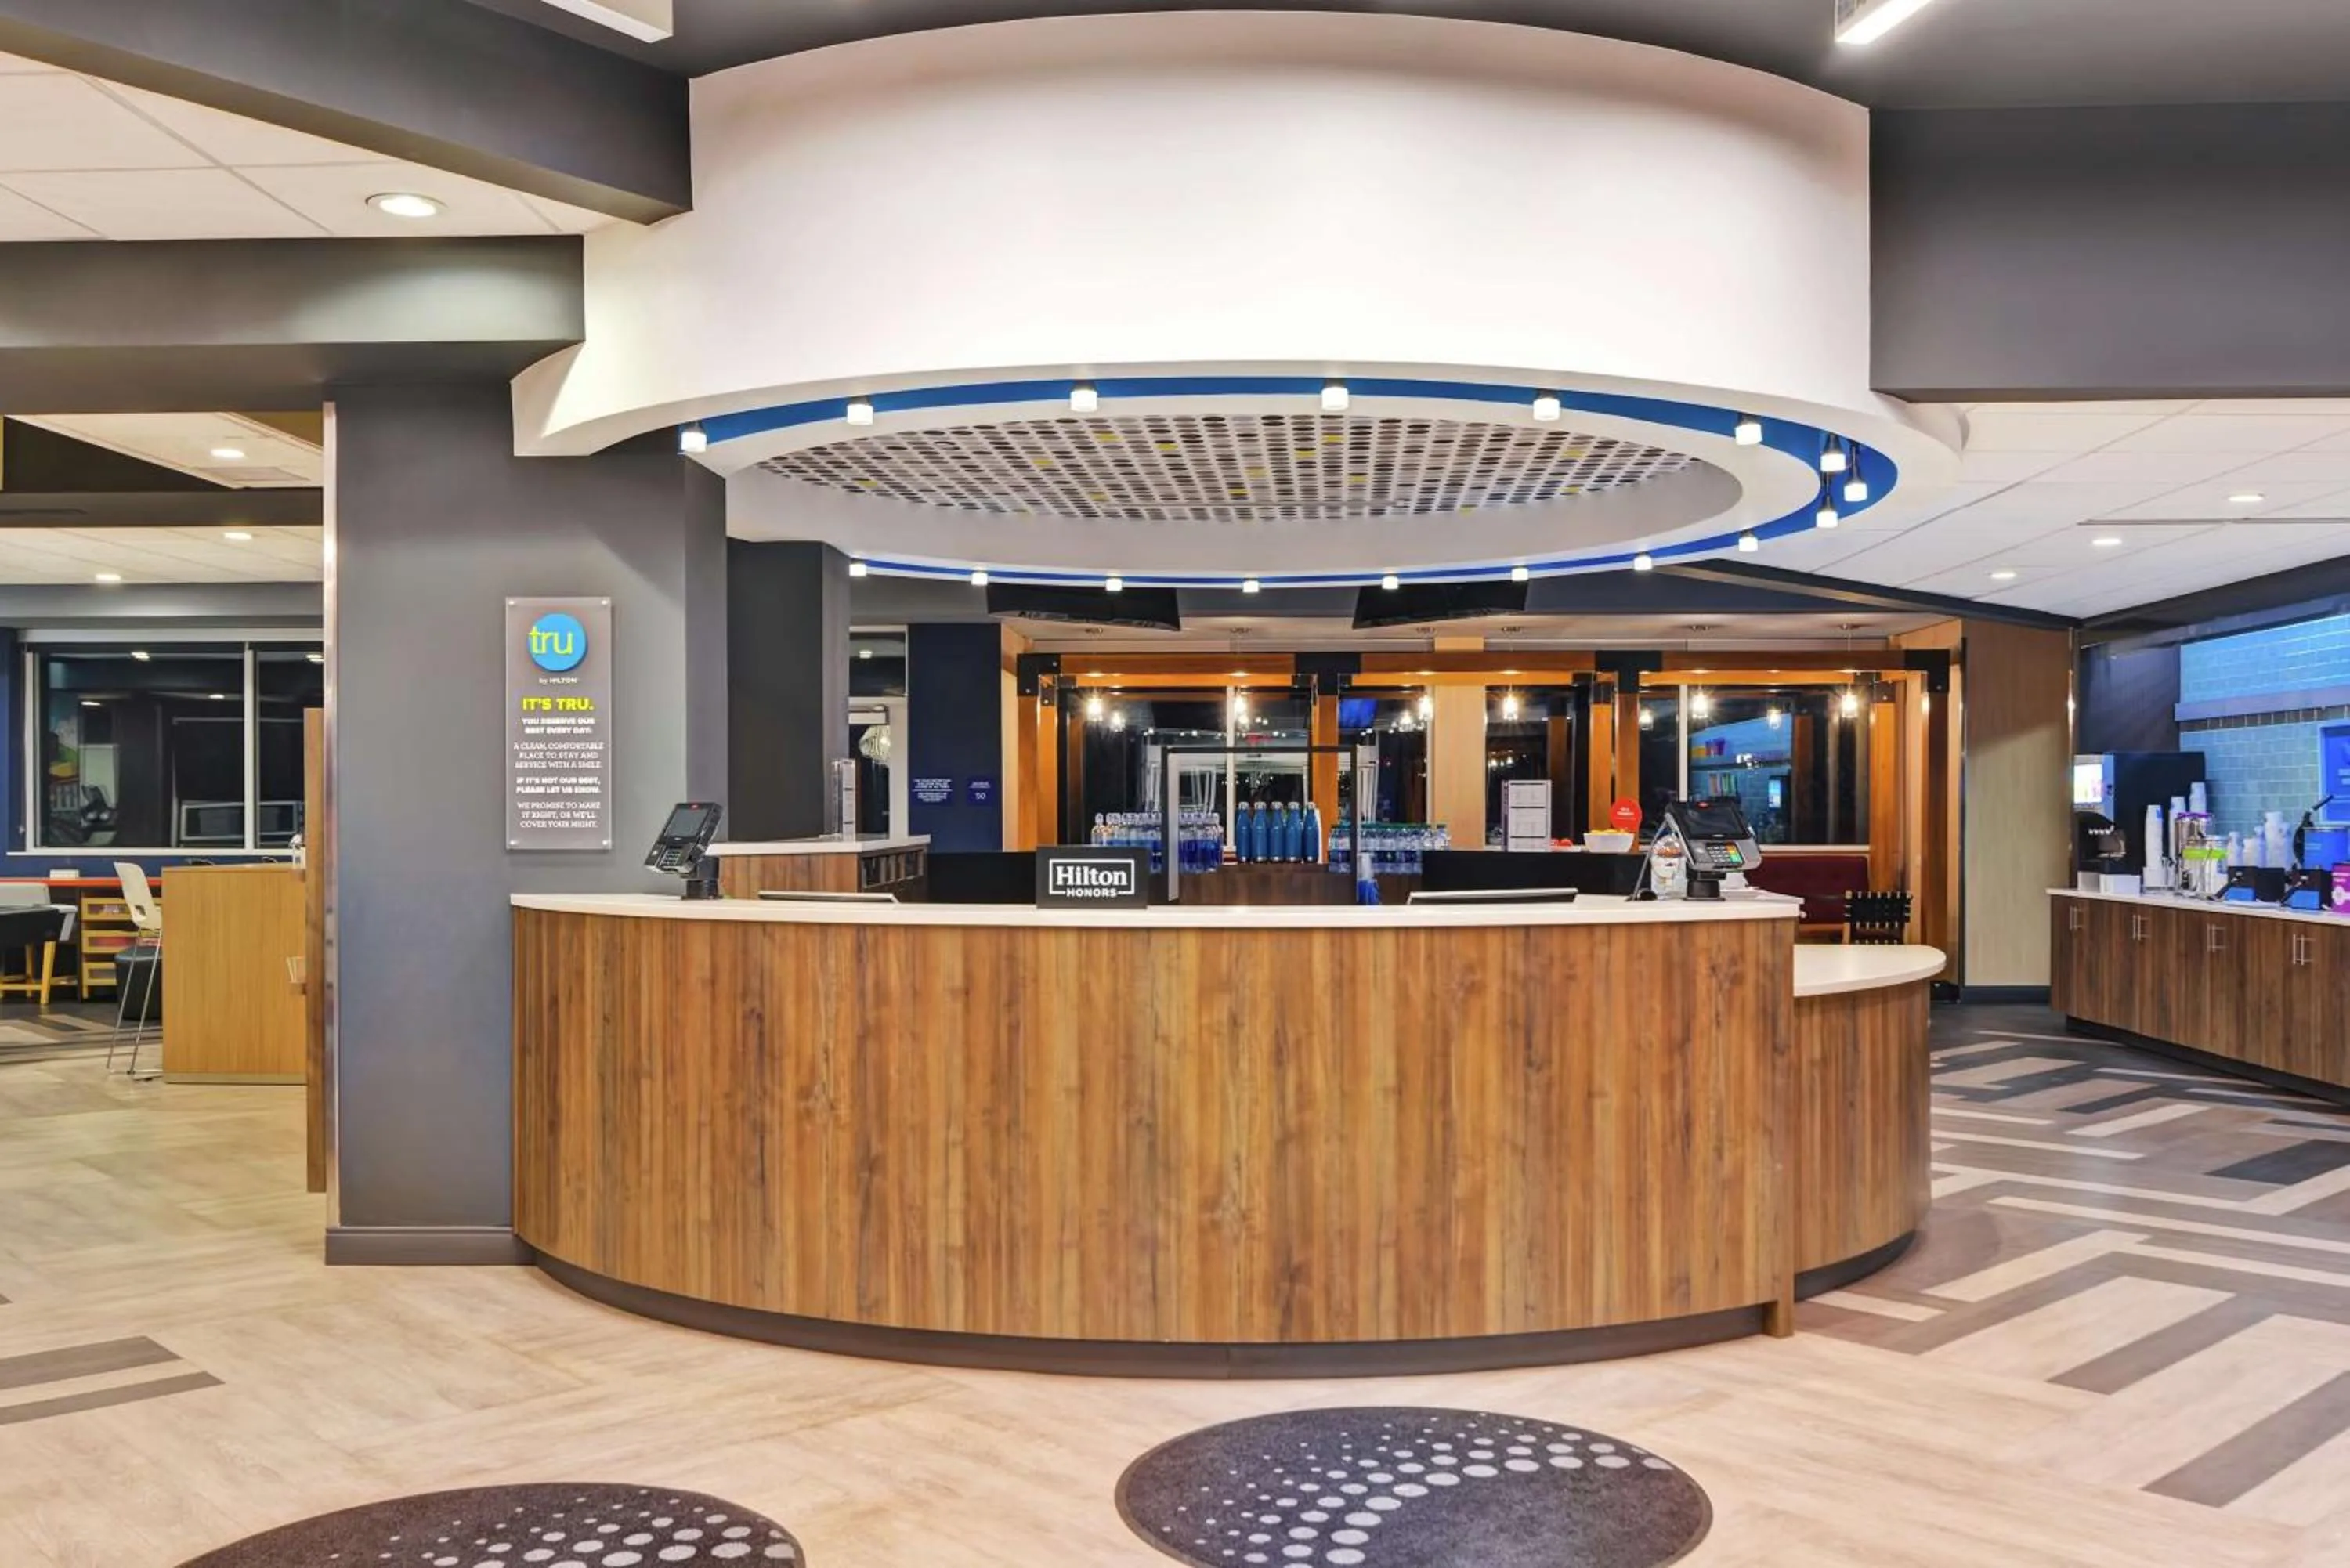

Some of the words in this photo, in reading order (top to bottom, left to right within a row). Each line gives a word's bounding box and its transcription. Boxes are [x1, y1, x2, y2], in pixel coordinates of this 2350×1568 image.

[529, 627, 573, 655] tru
[522, 698, 552, 710] IT'S
[556, 698, 594, 710] TRU.
[1056, 865, 1128, 886] Hilton
[1066, 887, 1118, 898] HONORS
